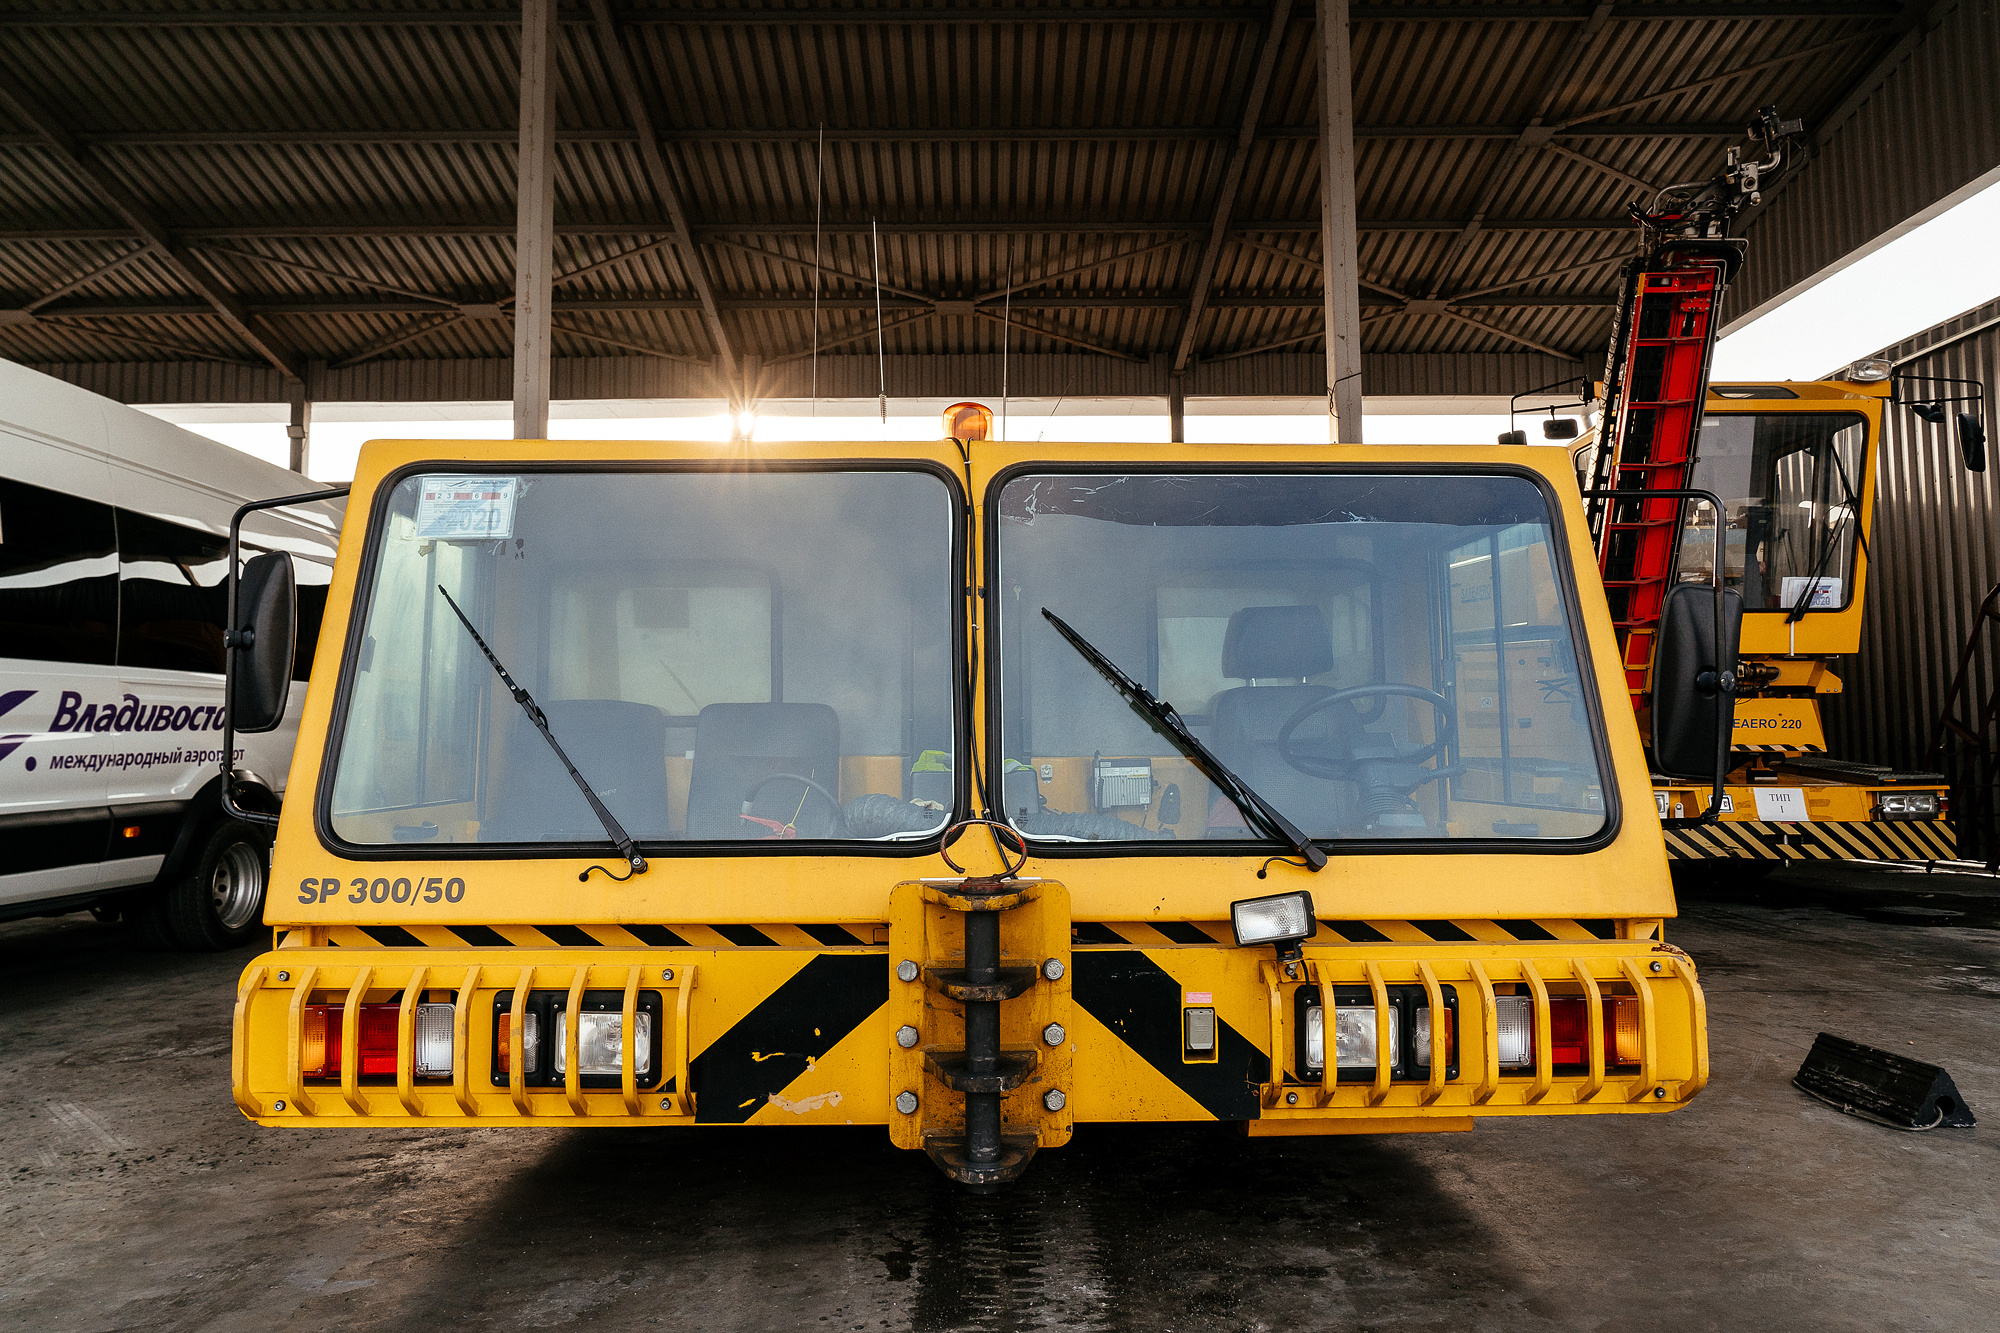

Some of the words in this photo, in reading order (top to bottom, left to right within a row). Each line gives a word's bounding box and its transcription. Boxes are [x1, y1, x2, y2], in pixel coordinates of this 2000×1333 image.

[443, 507, 501, 531] 2020
[48, 690, 225, 733] Владивосто
[1732, 718, 1778, 729] EAERO
[1781, 718, 1802, 729] 220
[50, 746, 183, 772] международный
[1768, 793, 1791, 802] ТИП
[297, 877, 341, 905] SP
[347, 877, 466, 906] 300/50
